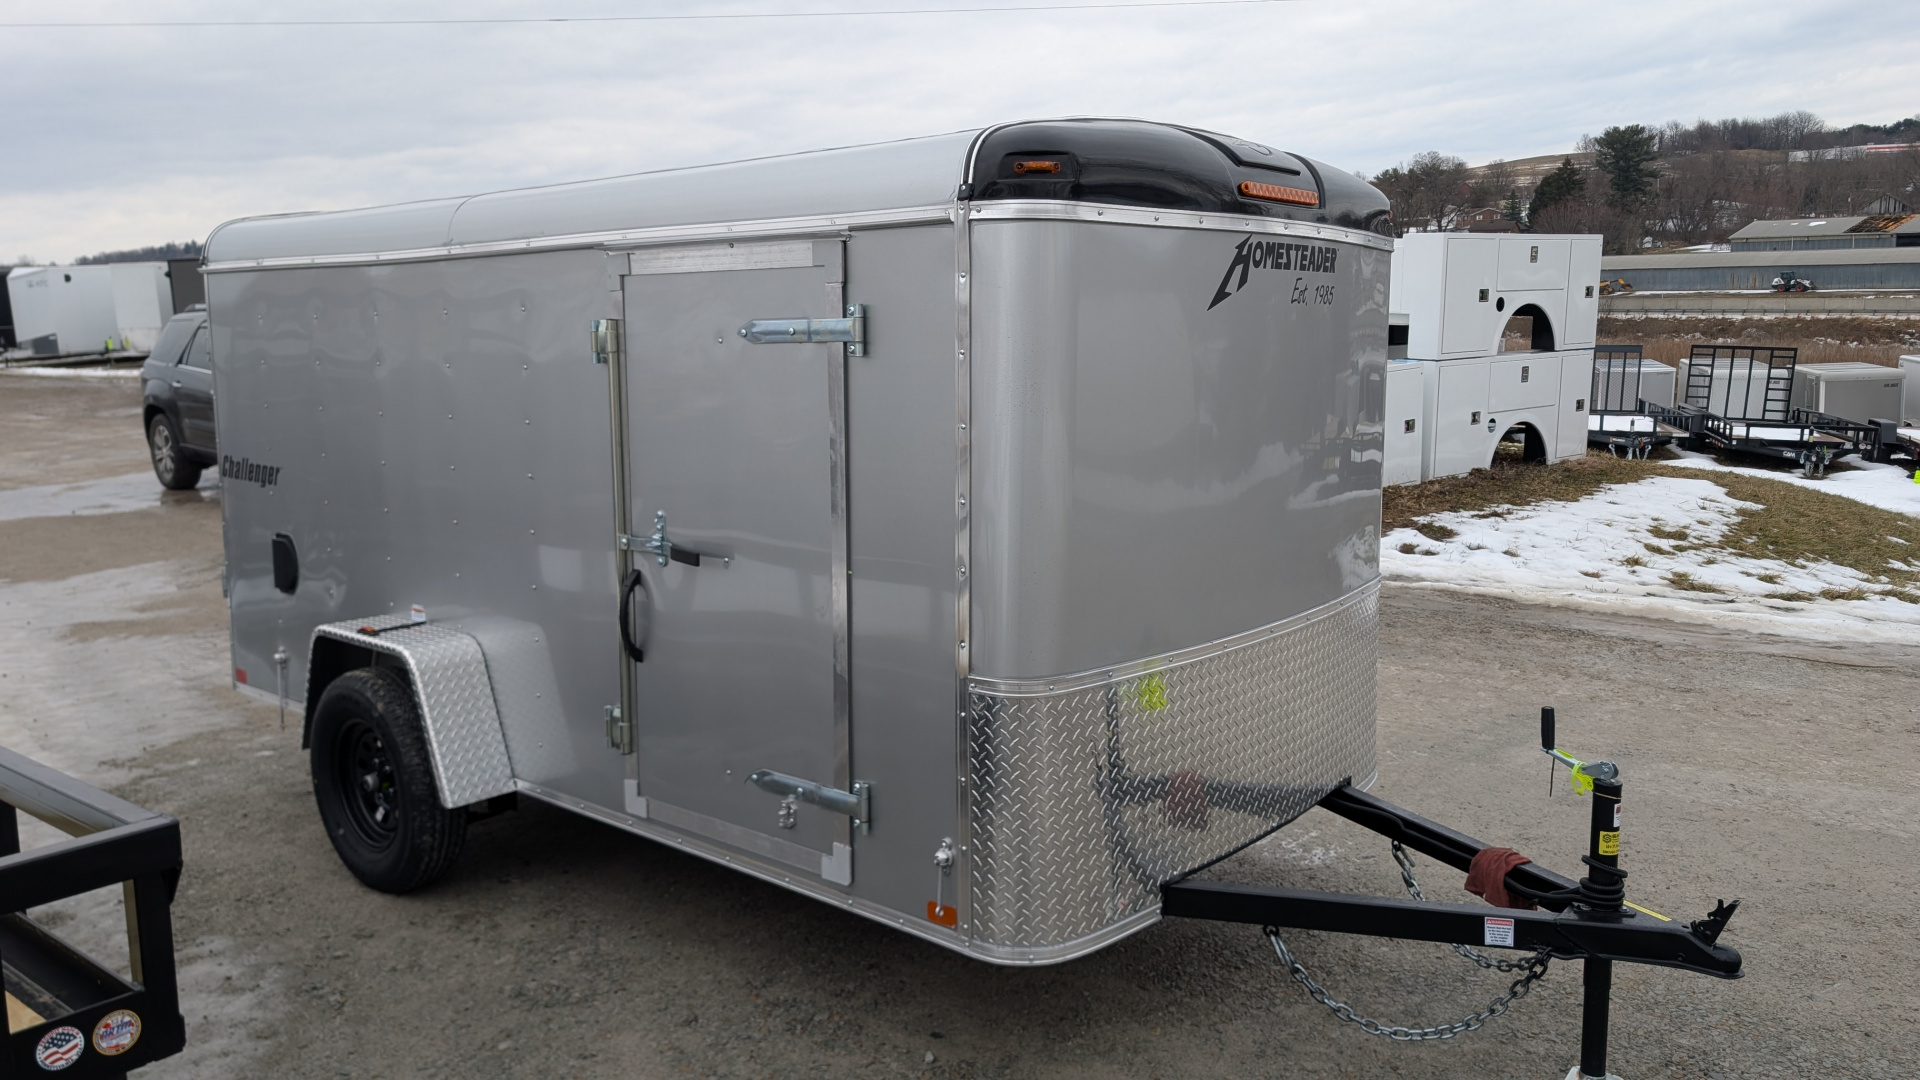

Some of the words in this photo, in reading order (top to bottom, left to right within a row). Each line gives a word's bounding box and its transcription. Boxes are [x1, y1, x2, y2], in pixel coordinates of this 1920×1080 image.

[1207, 234, 1337, 311] HOMESTEADER
[1314, 284, 1335, 306] 1985
[1782, 450, 1796, 458] CAM
[222, 454, 281, 488] Challenger
